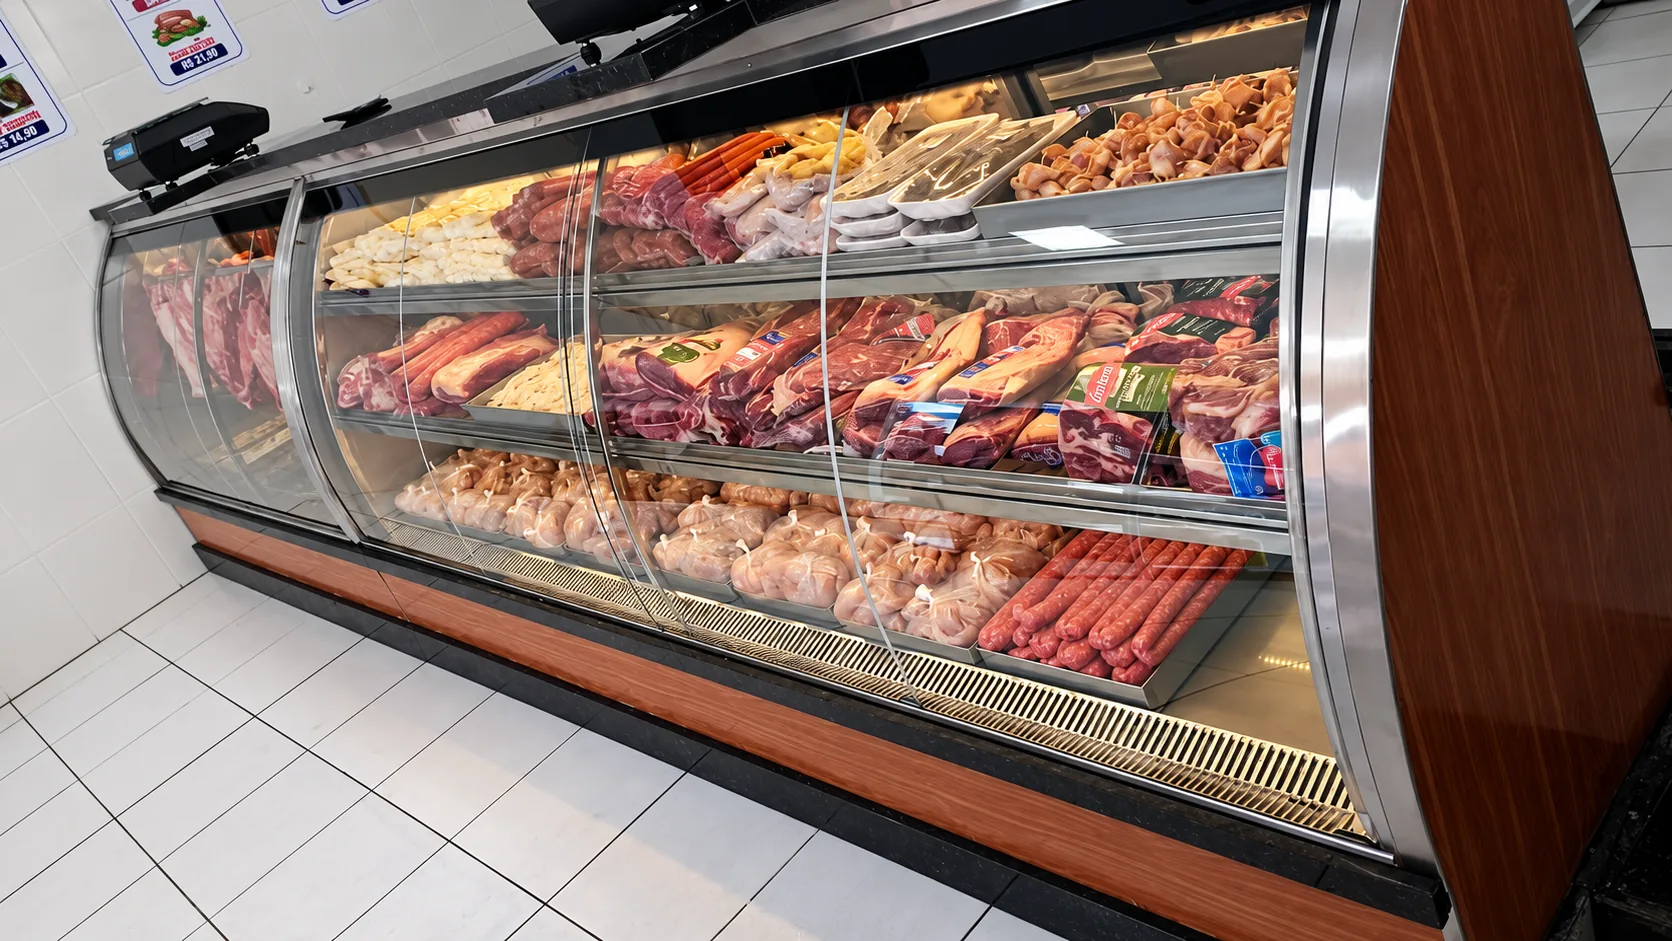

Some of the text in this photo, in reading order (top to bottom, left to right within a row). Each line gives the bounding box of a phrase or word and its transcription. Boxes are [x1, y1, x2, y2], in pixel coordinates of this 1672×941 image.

[181, 59, 195, 71] R$
[194, 47, 219, 65] 21,90
[9, 125, 38, 144] 14,90
